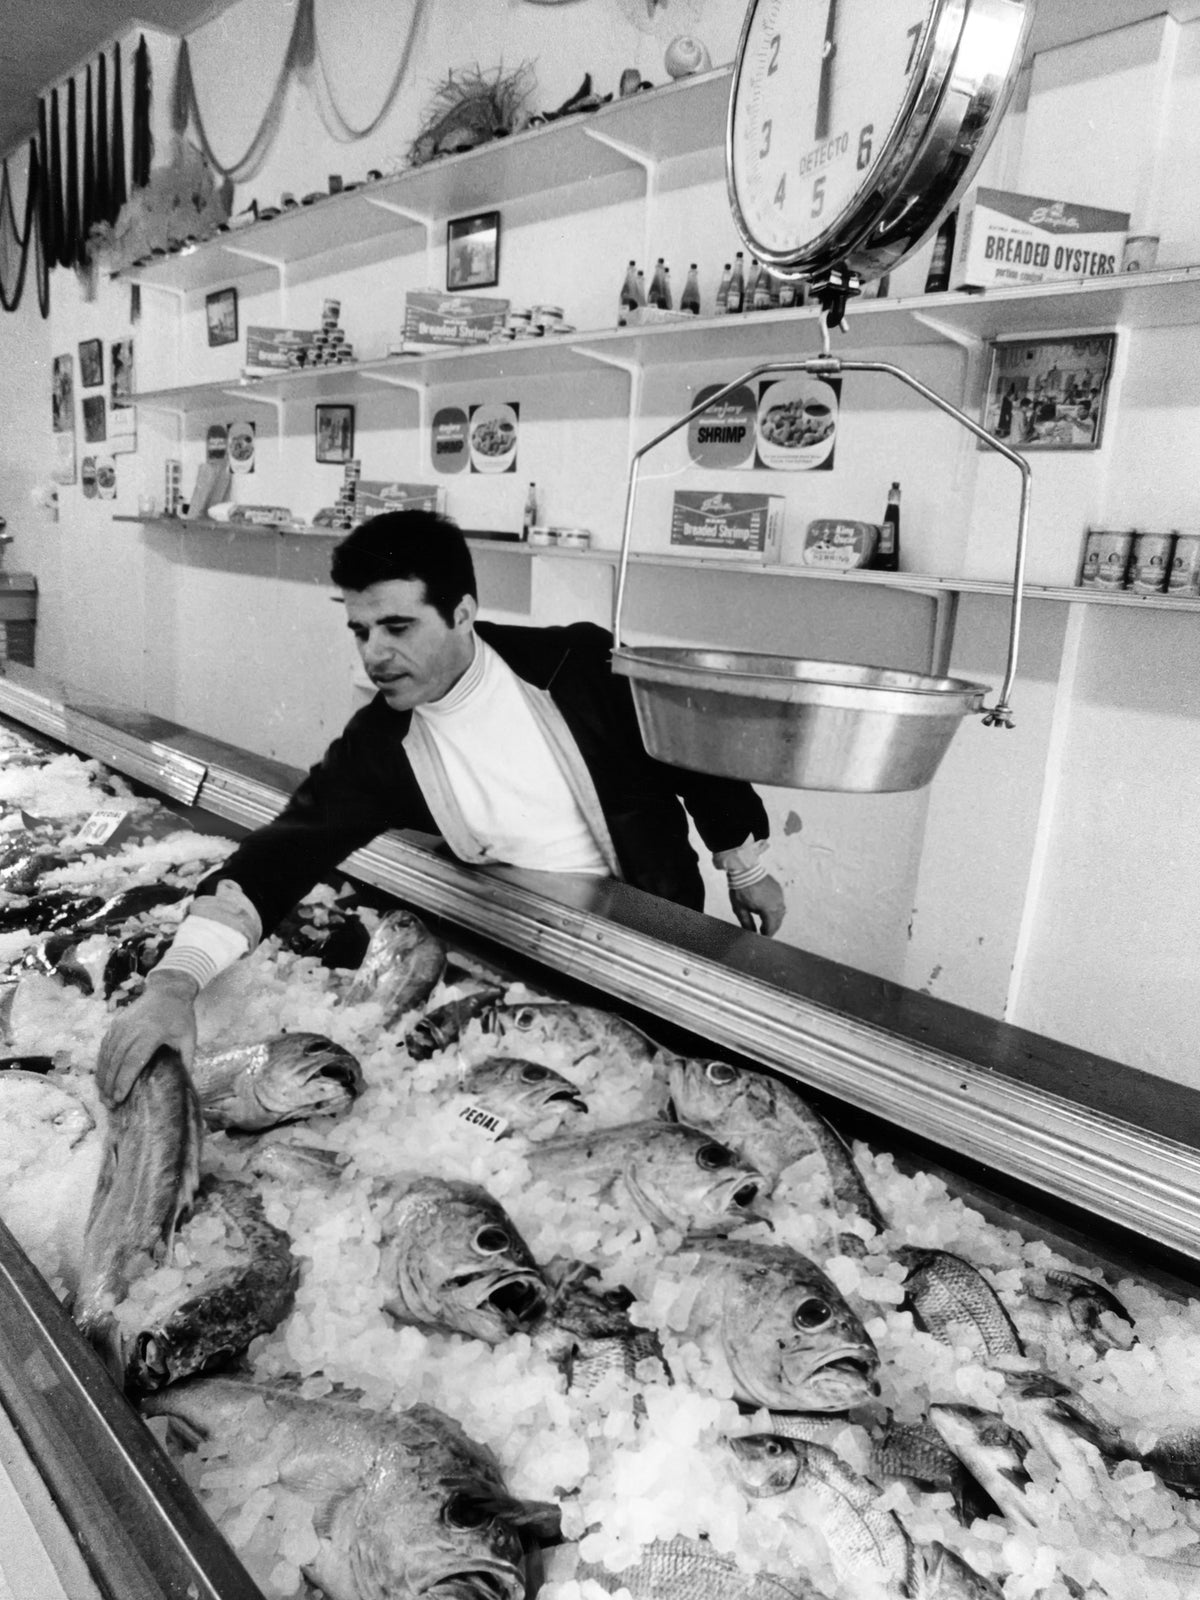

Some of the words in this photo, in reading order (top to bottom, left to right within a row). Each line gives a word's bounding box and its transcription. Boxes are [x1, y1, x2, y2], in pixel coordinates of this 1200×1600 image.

[767, 34, 781, 76] 2
[905, 21, 923, 75] 7
[759, 119, 772, 159] 3
[799, 132, 849, 176] DETECTO
[857, 124, 874, 171] 6
[773, 173, 786, 210] 4
[810, 177, 826, 218] 5
[985, 236, 1050, 268] BREADED
[1054, 246, 1115, 276] OYSTERS
[697, 426, 746, 443] SHRIMP
[459, 1107, 498, 1132] PECIAL
